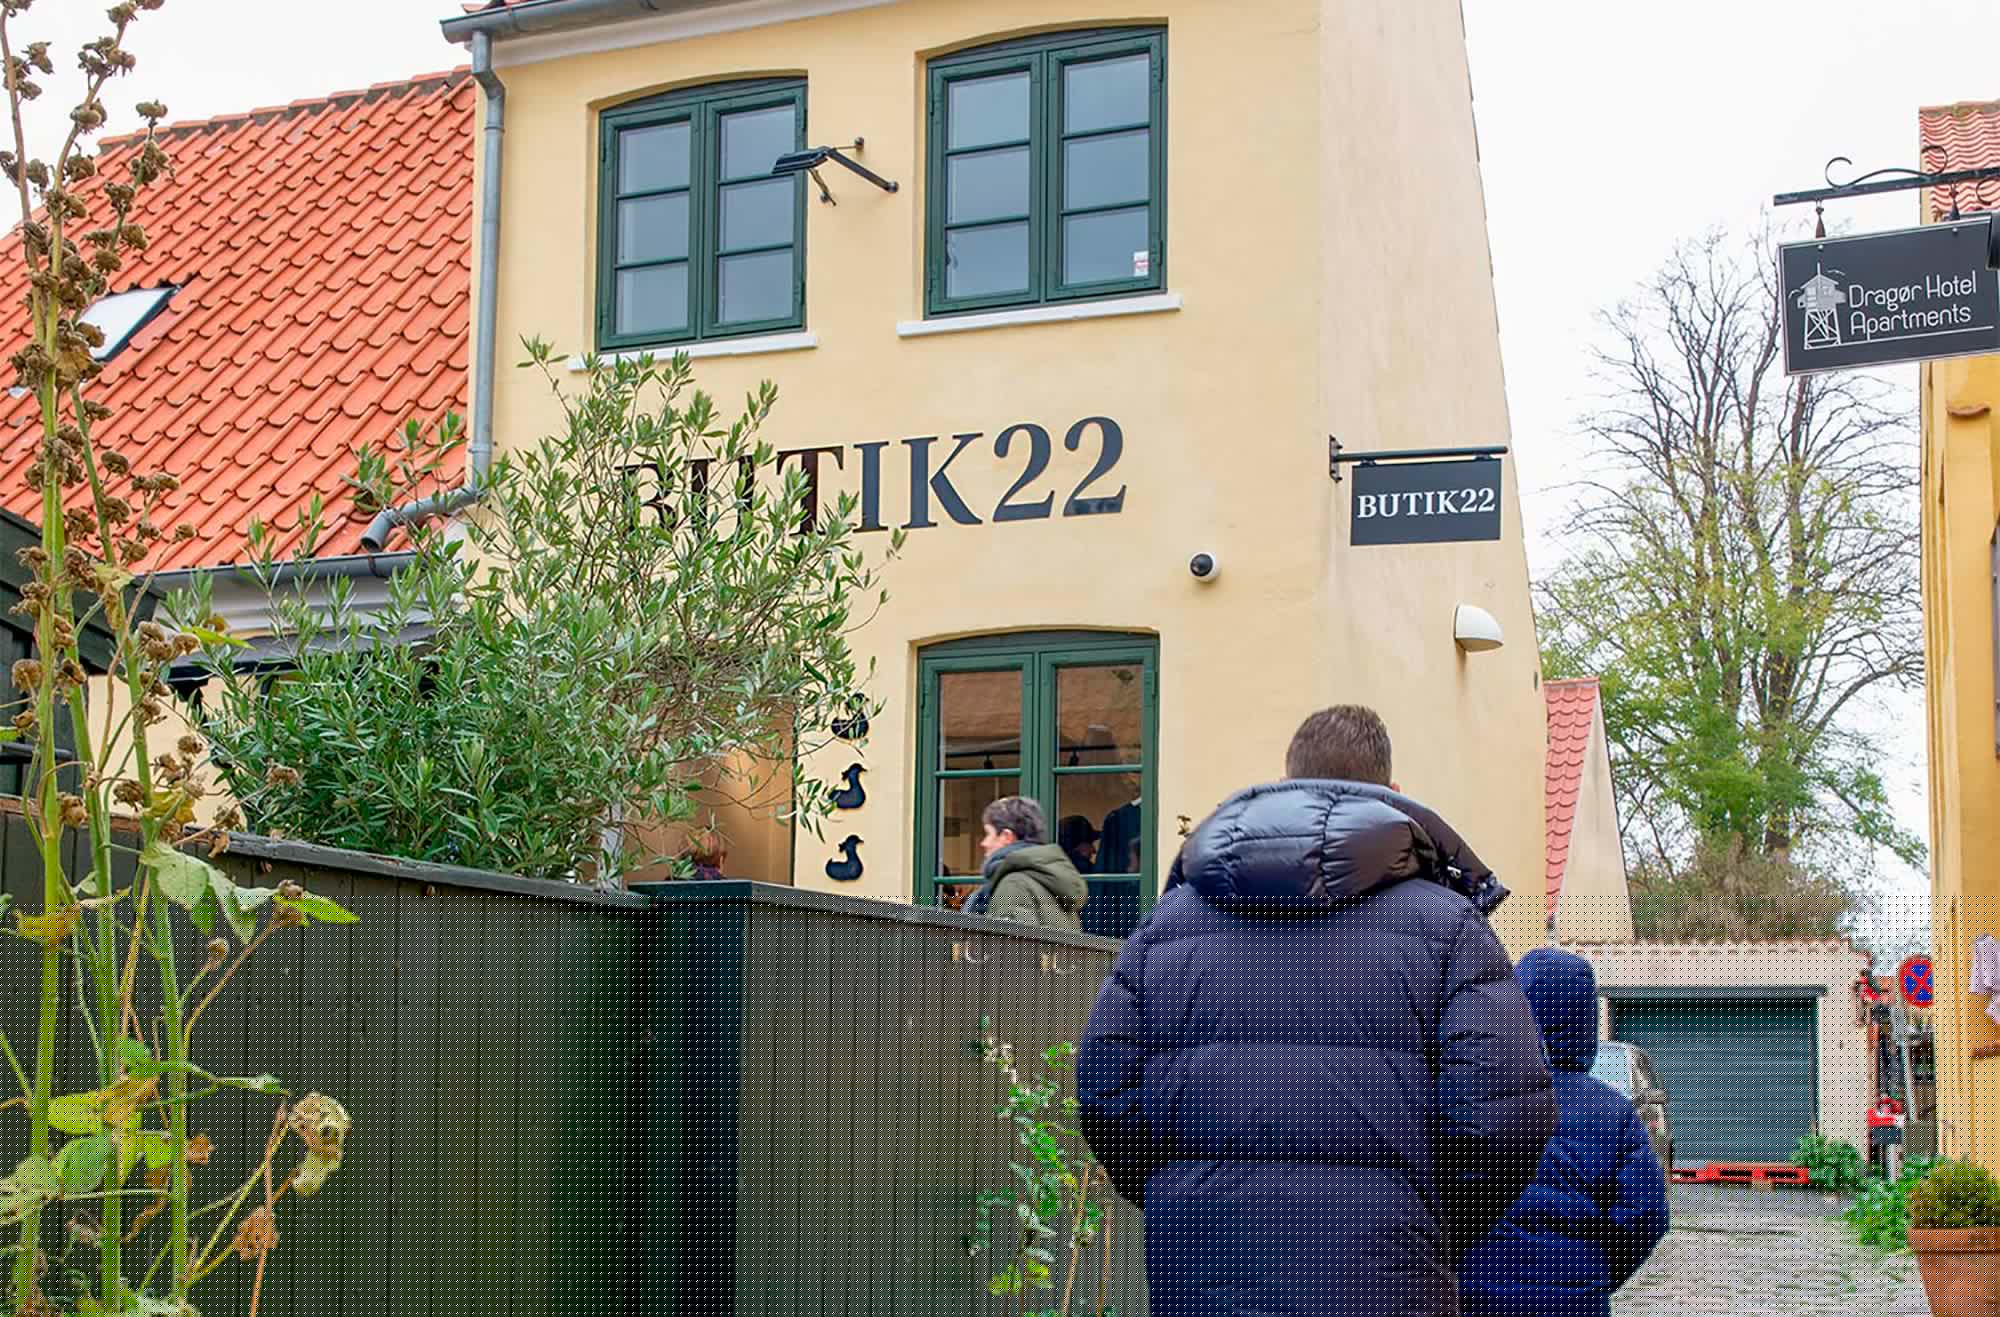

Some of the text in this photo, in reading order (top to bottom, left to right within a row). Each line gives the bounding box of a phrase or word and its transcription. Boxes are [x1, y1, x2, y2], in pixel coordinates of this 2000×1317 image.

[1849, 270, 1977, 311] Dragør Hotel
[1850, 304, 1972, 340] Apartments
[1357, 488, 1496, 518] BUTIK22
